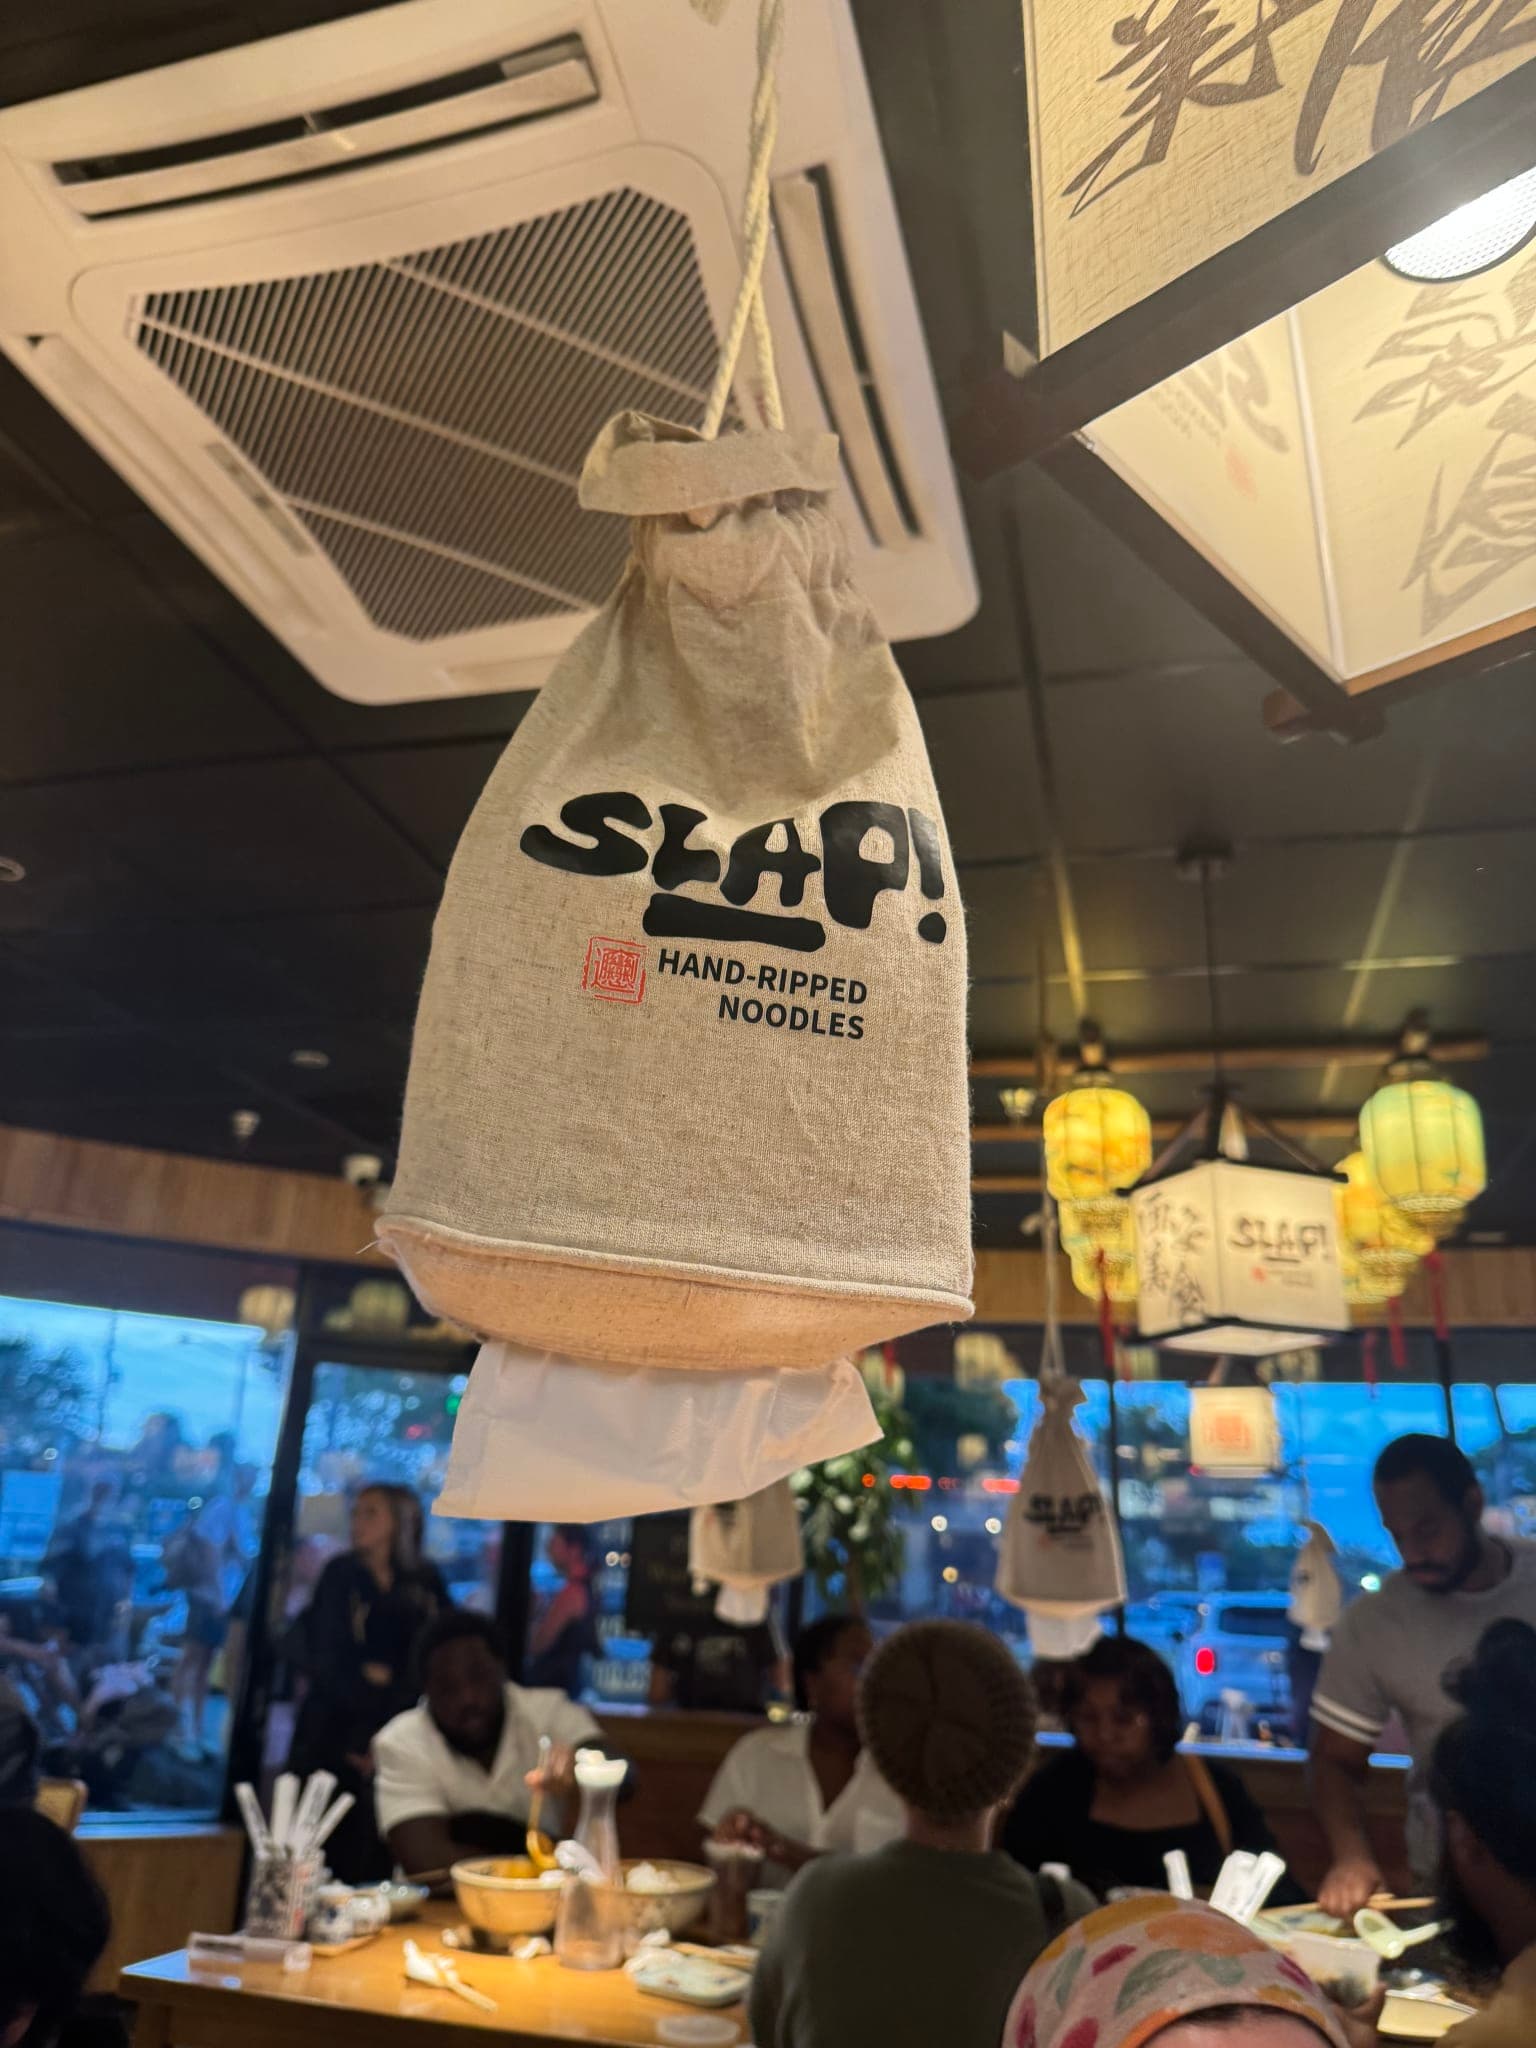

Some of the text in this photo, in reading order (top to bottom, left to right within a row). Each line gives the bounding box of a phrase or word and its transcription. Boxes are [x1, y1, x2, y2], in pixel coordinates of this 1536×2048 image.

[520, 791, 948, 944] SLAP!
[658, 948, 868, 1005] HAND-RIPPED
[718, 994, 865, 1040] NOODLES
